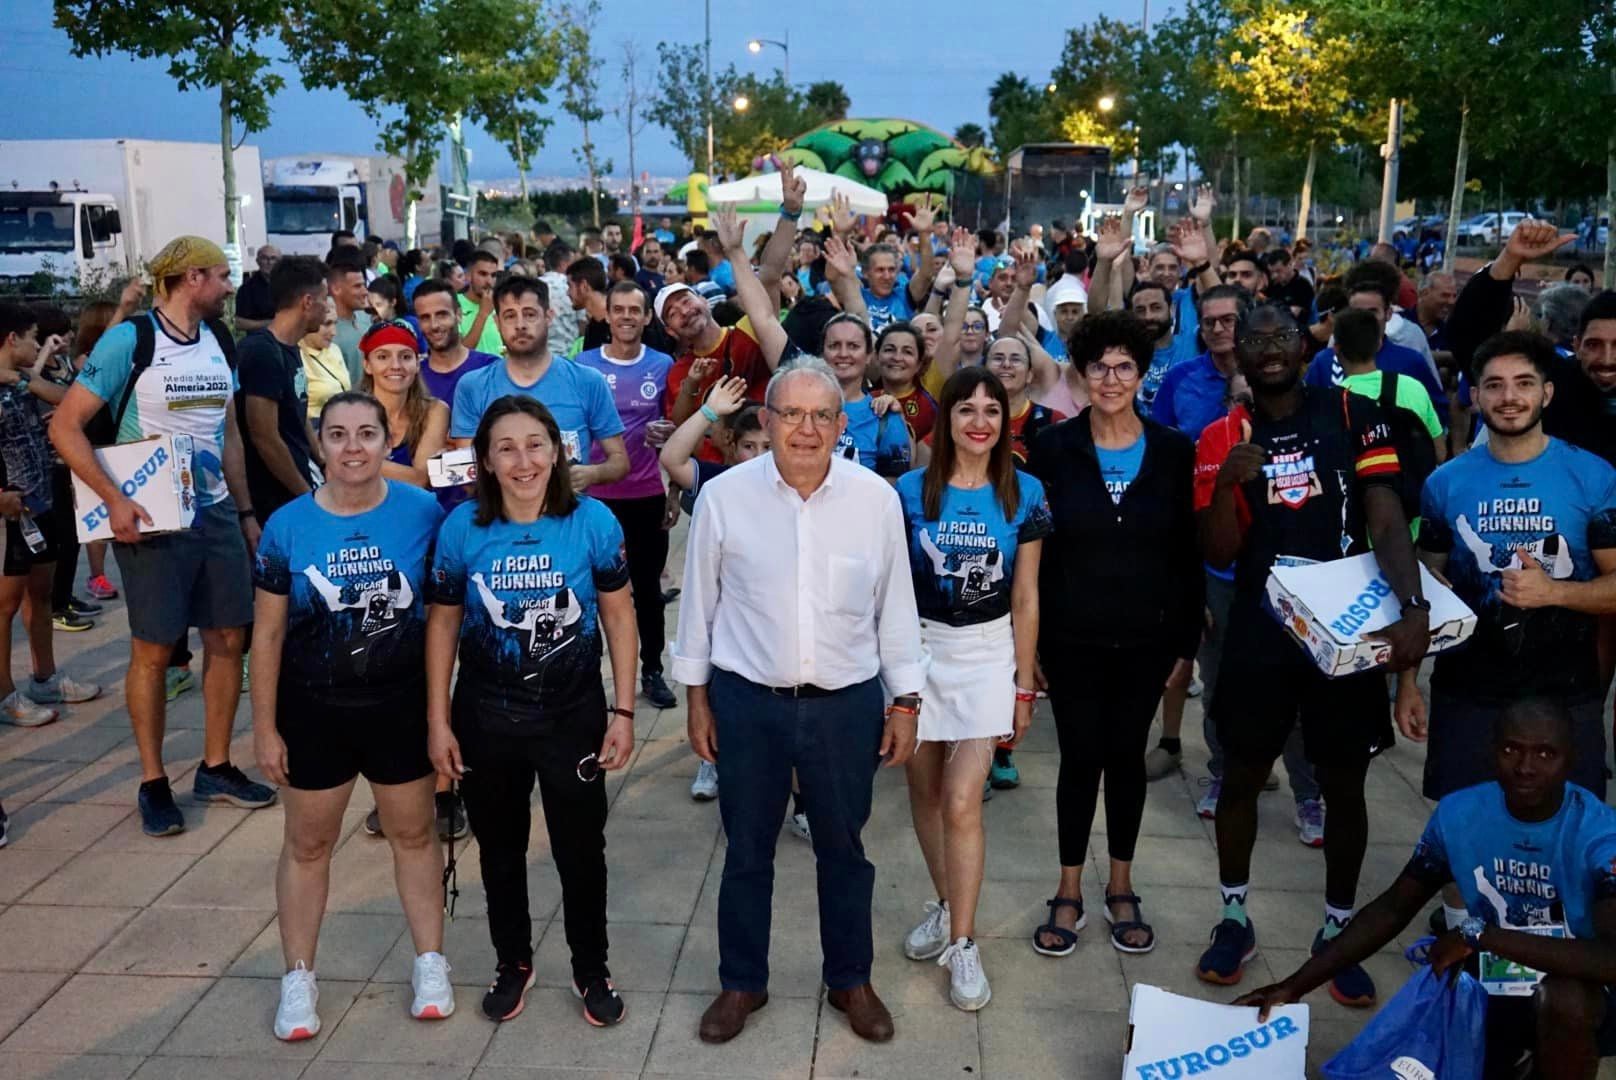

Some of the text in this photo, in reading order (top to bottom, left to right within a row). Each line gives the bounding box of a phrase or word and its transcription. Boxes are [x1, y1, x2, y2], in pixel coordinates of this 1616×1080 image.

[206, 381, 228, 391] 2022
[1262, 456, 1315, 478] TEAM
[81, 446, 168, 531] EUOSUR
[1478, 498, 1540, 514] II ROAD
[938, 521, 986, 534] II ROAD
[1478, 516, 1554, 533] RUNNING
[936, 533, 996, 548] RUNNING
[326, 546, 380, 563] II ROAD
[506, 554, 550, 572] ROAD
[327, 559, 394, 578] RUNNING
[355, 581, 383, 591] VICAR
[491, 571, 564, 590] RUNNING
[519, 598, 550, 609] VICAR
[1330, 570, 1392, 637] ROSUR
[1493, 856, 1552, 880] II ROAD
[1136, 1016, 1299, 1080] EUROSUR
[1398, 1059, 1428, 1080] EUR
